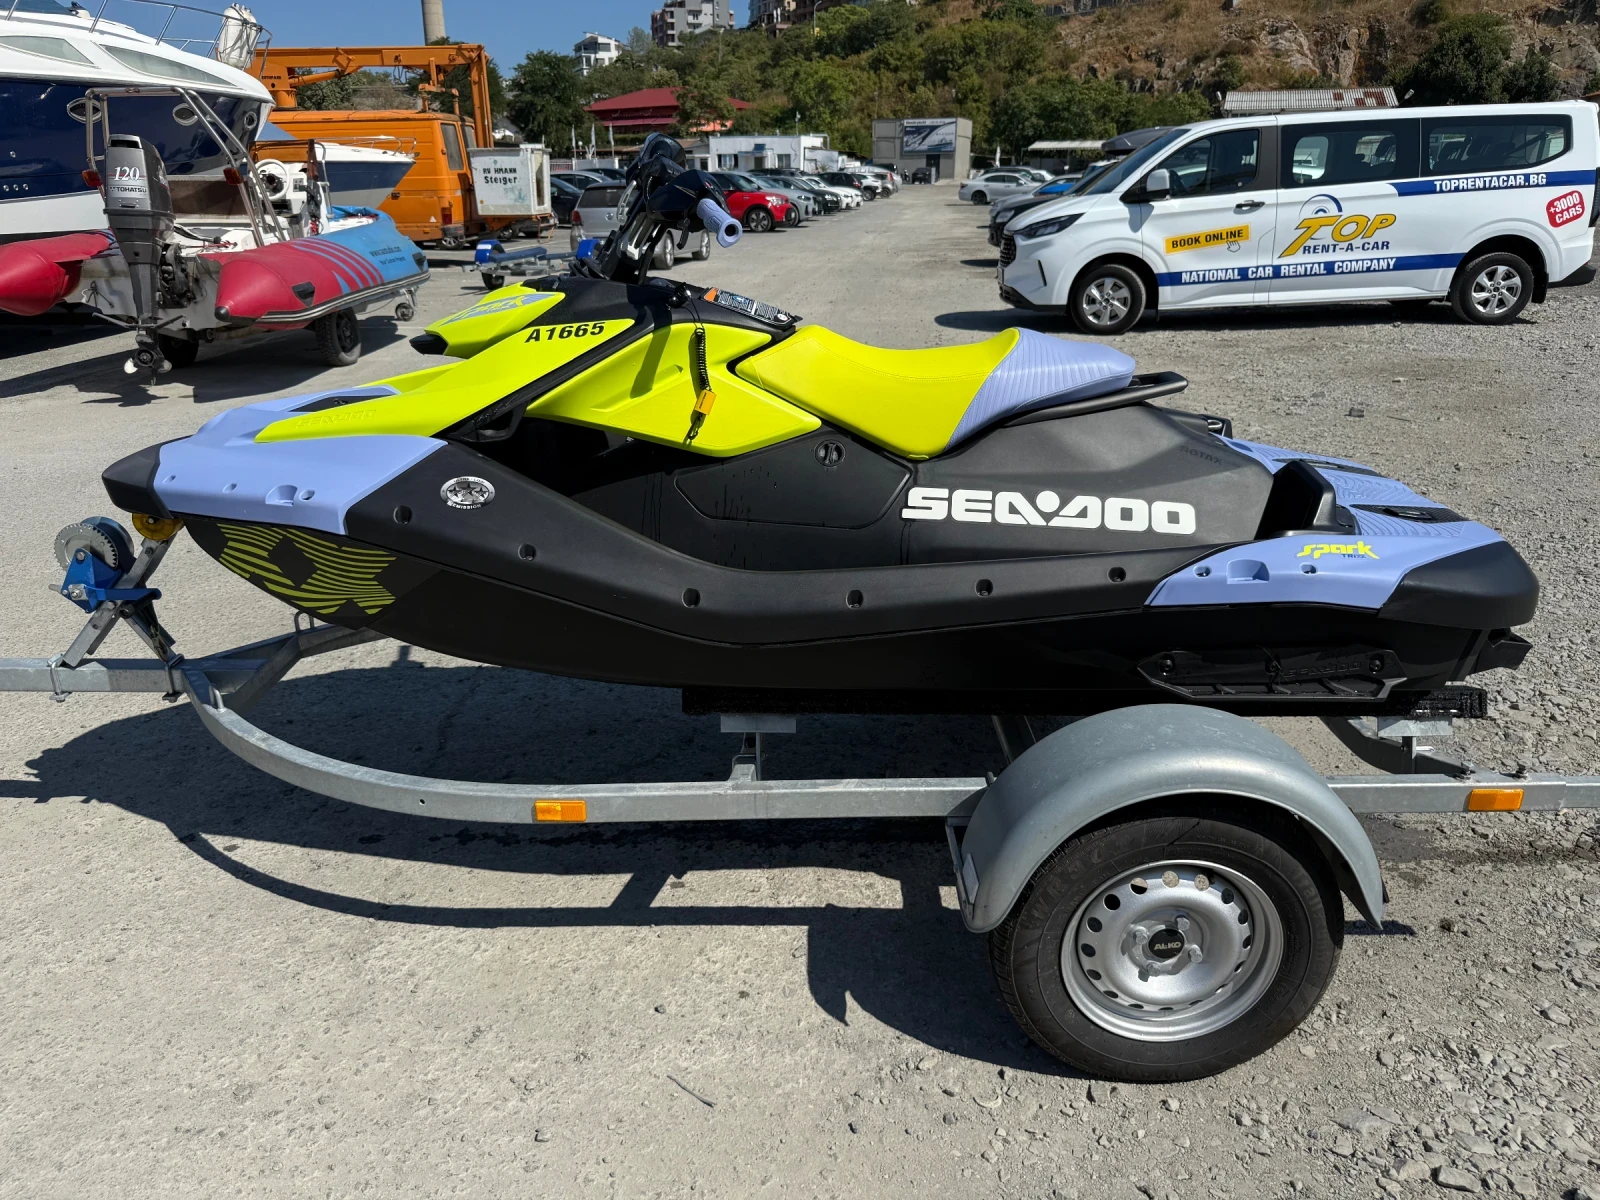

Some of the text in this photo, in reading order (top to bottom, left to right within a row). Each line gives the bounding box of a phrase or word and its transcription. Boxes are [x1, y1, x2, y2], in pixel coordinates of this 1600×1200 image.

[114, 166, 140, 181] 120
[484, 175, 517, 185] Steiger
[1434, 174, 1547, 192] TOPRENTACAR.BG
[1549, 192, 1580, 214] +3000
[1555, 204, 1583, 224] CARS
[1171, 229, 1244, 249] BOOK ONLINE
[1277, 213, 1397, 259] TOP
[1302, 240, 1390, 255] RENT-A-CAR
[1181, 258, 1397, 283] NATIONAL CAR RENTAL COMPANY
[524, 321, 606, 343] A1665
